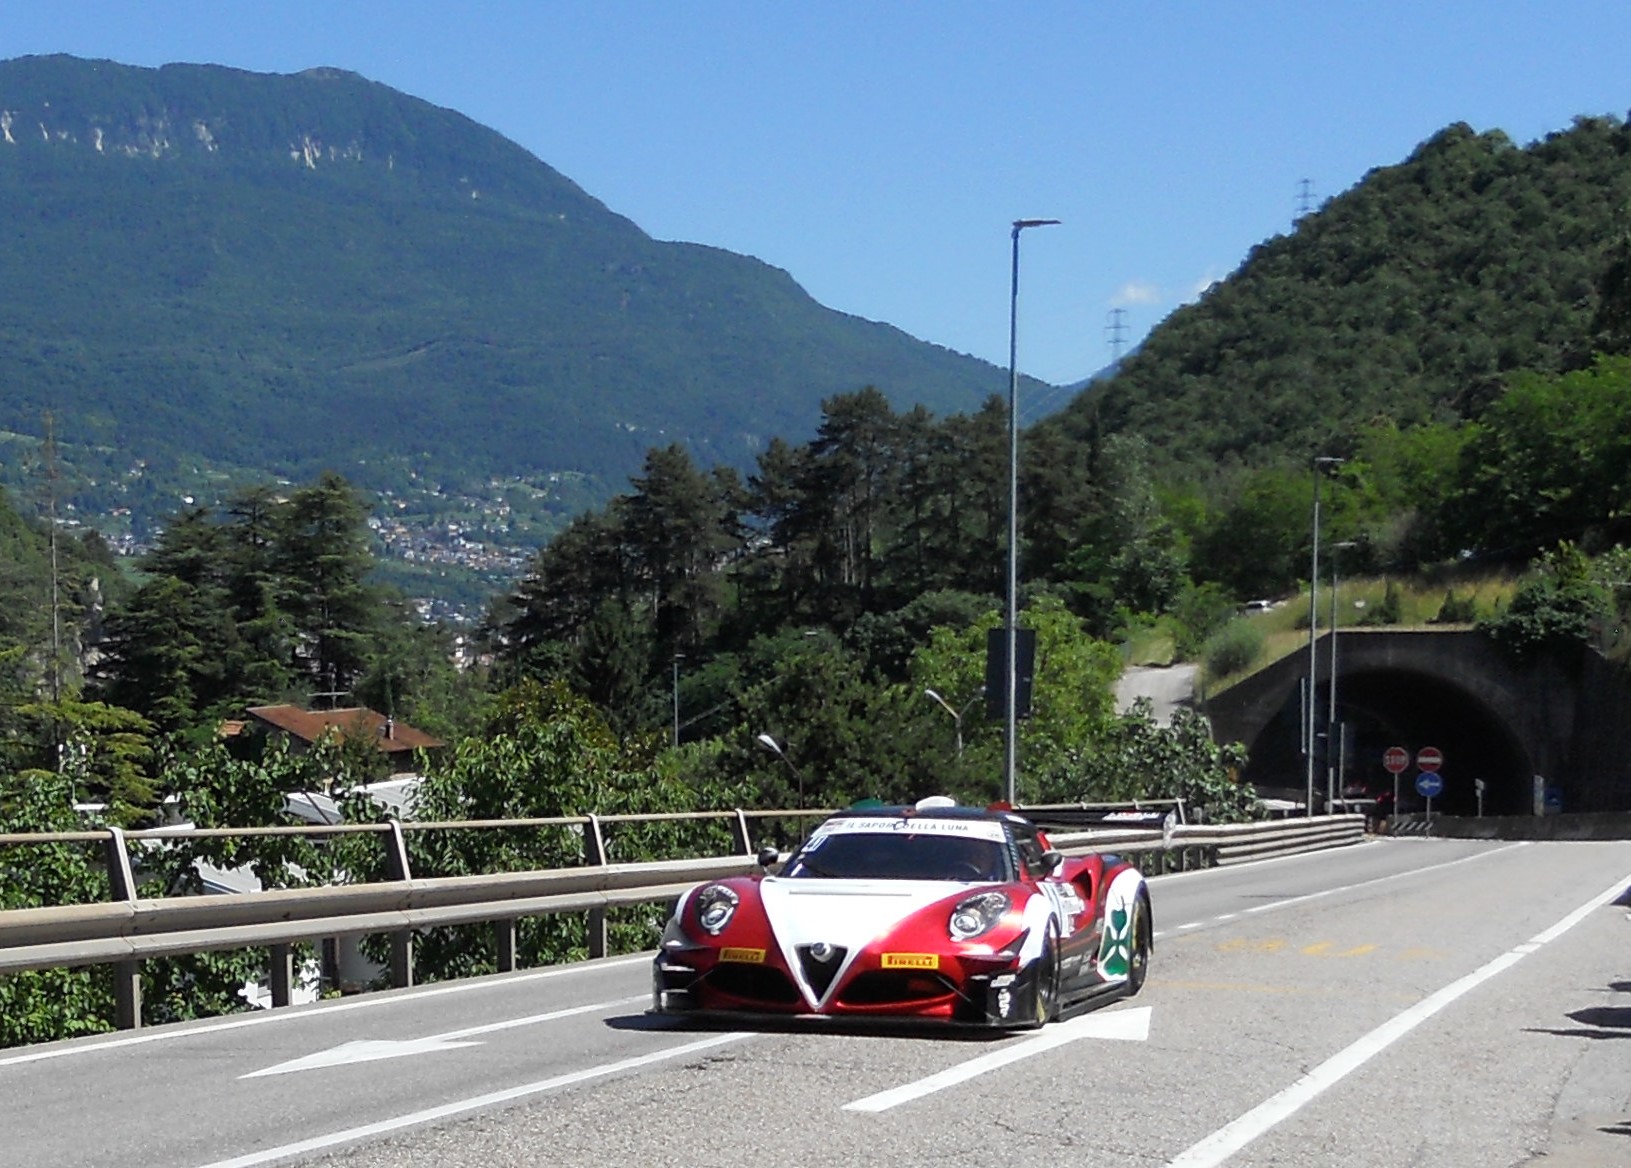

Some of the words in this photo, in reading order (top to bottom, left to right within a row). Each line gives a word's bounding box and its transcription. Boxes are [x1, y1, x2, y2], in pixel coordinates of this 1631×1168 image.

[1385, 755, 1406, 765] STOP
[942, 823, 969, 832] LUNA
[723, 949, 761, 961] PIRELLI
[887, 955, 933, 966] PIRELLI
